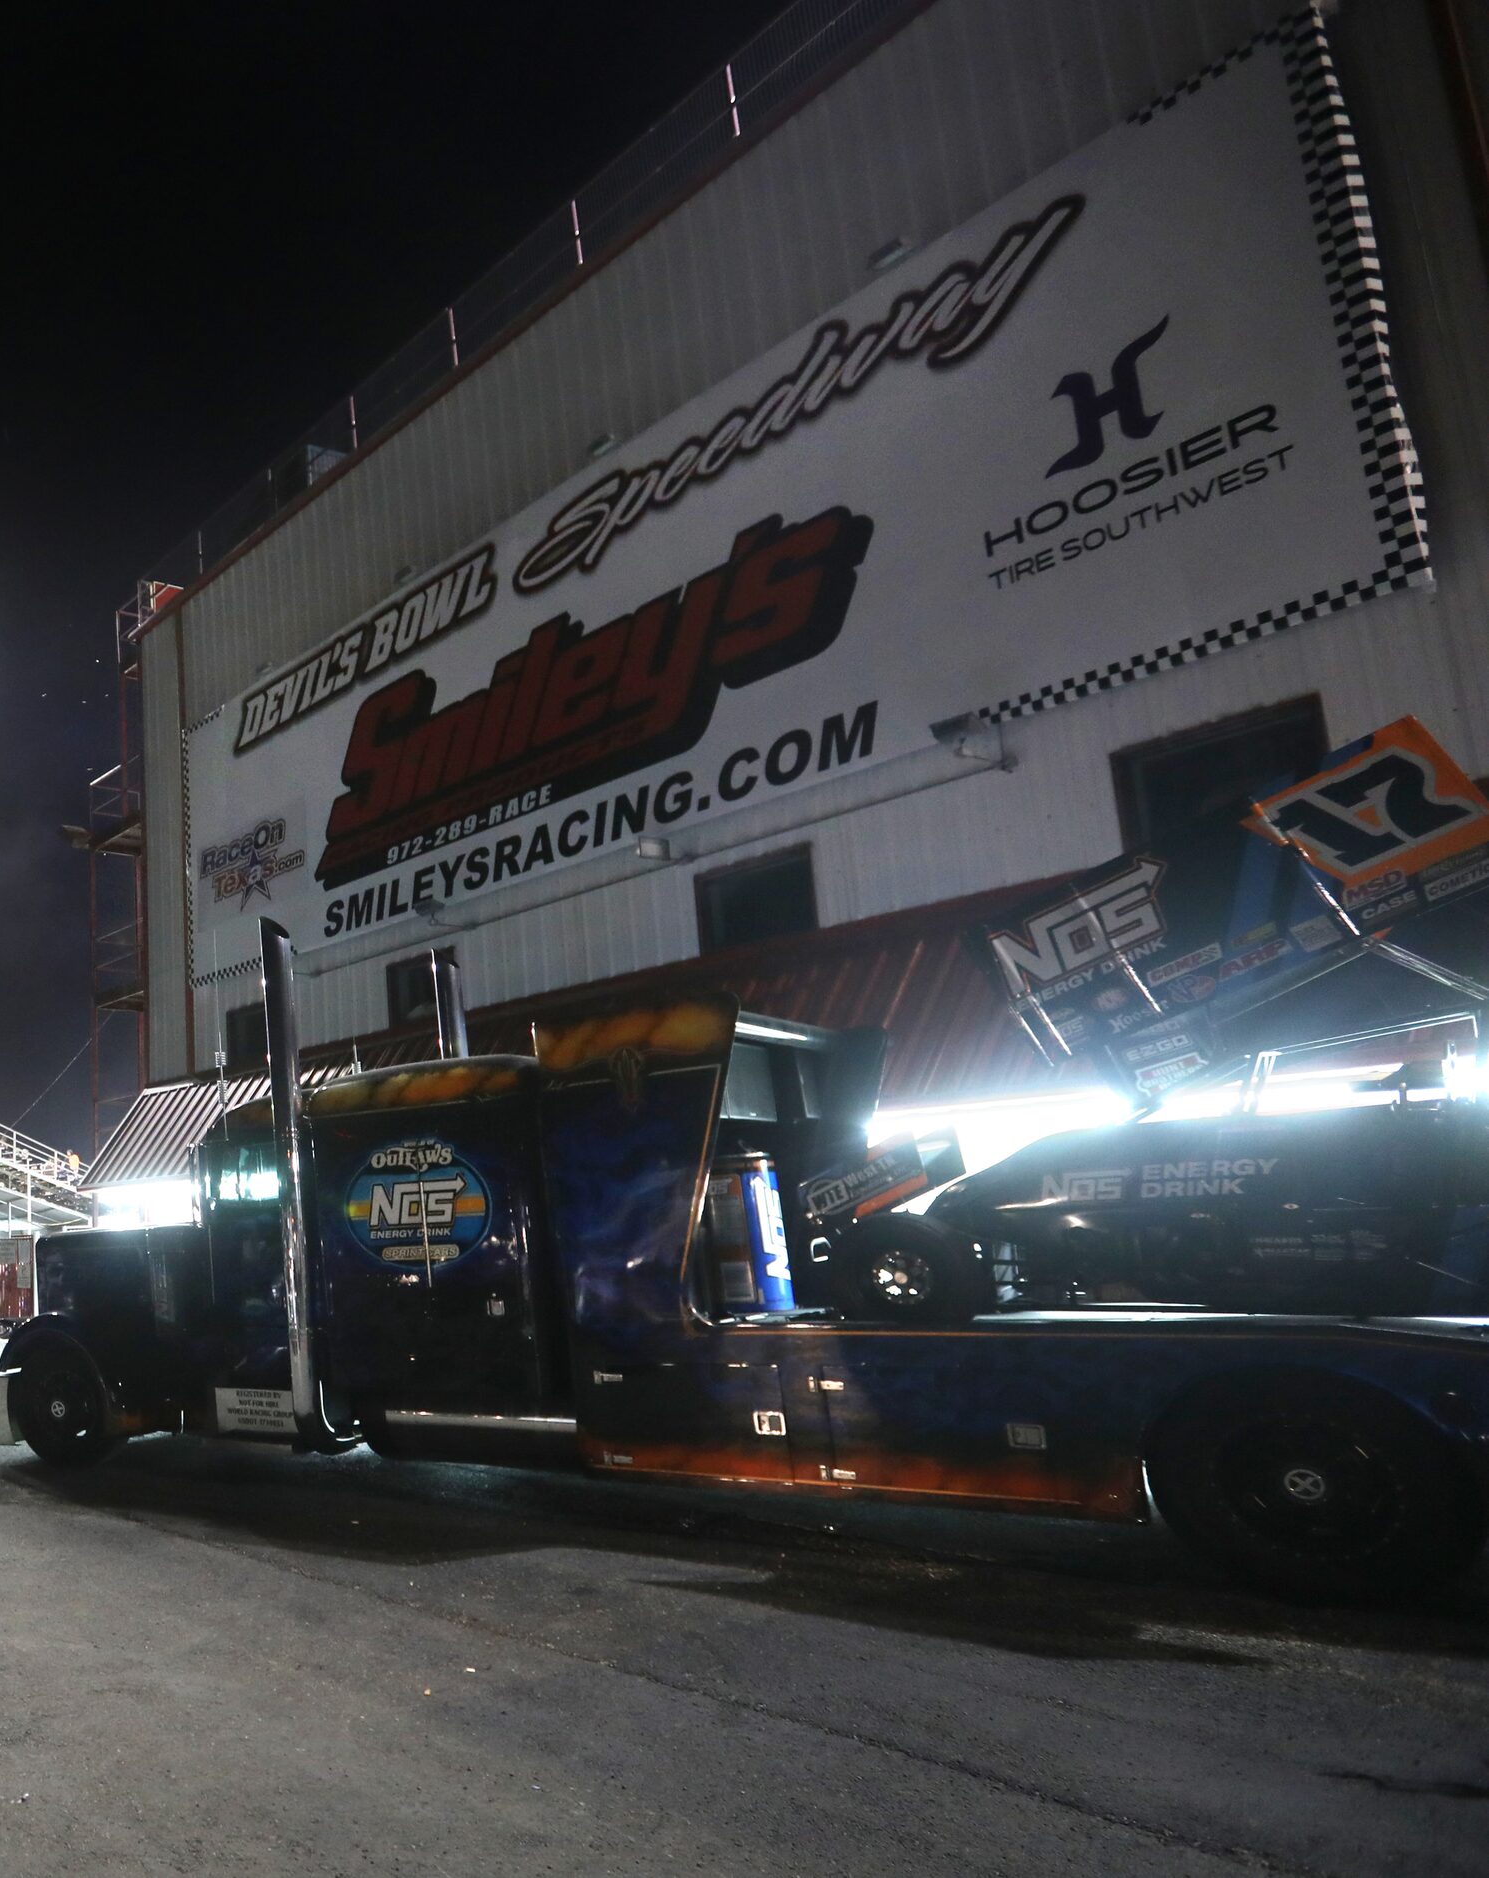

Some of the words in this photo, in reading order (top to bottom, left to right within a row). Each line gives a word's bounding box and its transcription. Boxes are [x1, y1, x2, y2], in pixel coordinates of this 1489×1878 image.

[515, 196, 1081, 592] Speedway
[983, 403, 1280, 557] HOOSIER
[988, 549, 1056, 590] TIRE
[1061, 444, 1295, 562] SOUTHWEST
[241, 624, 360, 748] DEVIL'S
[366, 548, 495, 680] BOWL
[325, 508, 869, 845] Smiley's
[324, 700, 878, 939] SMILEYSRACING.COM
[386, 783, 554, 866] 972-289-RACE
[1268, 752, 1475, 868] 17
[991, 851, 1169, 985] NOS
[1346, 869, 1404, 904] MSD
[1361, 889, 1418, 920] CASE
[1101, 936, 1167, 976] DINK
[1109, 999, 1169, 1034] Hoosr
[369, 1171, 467, 1228] NOS
[1041, 1167, 1133, 1202] NOS
[1140, 1177, 1246, 1199] DRINK
[1141, 1158, 1280, 1181] ENERGY
[370, 1229, 414, 1240] ENERGY
[384, 1246, 425, 1259] SPRINT
[749, 1176, 792, 1281] NOS
